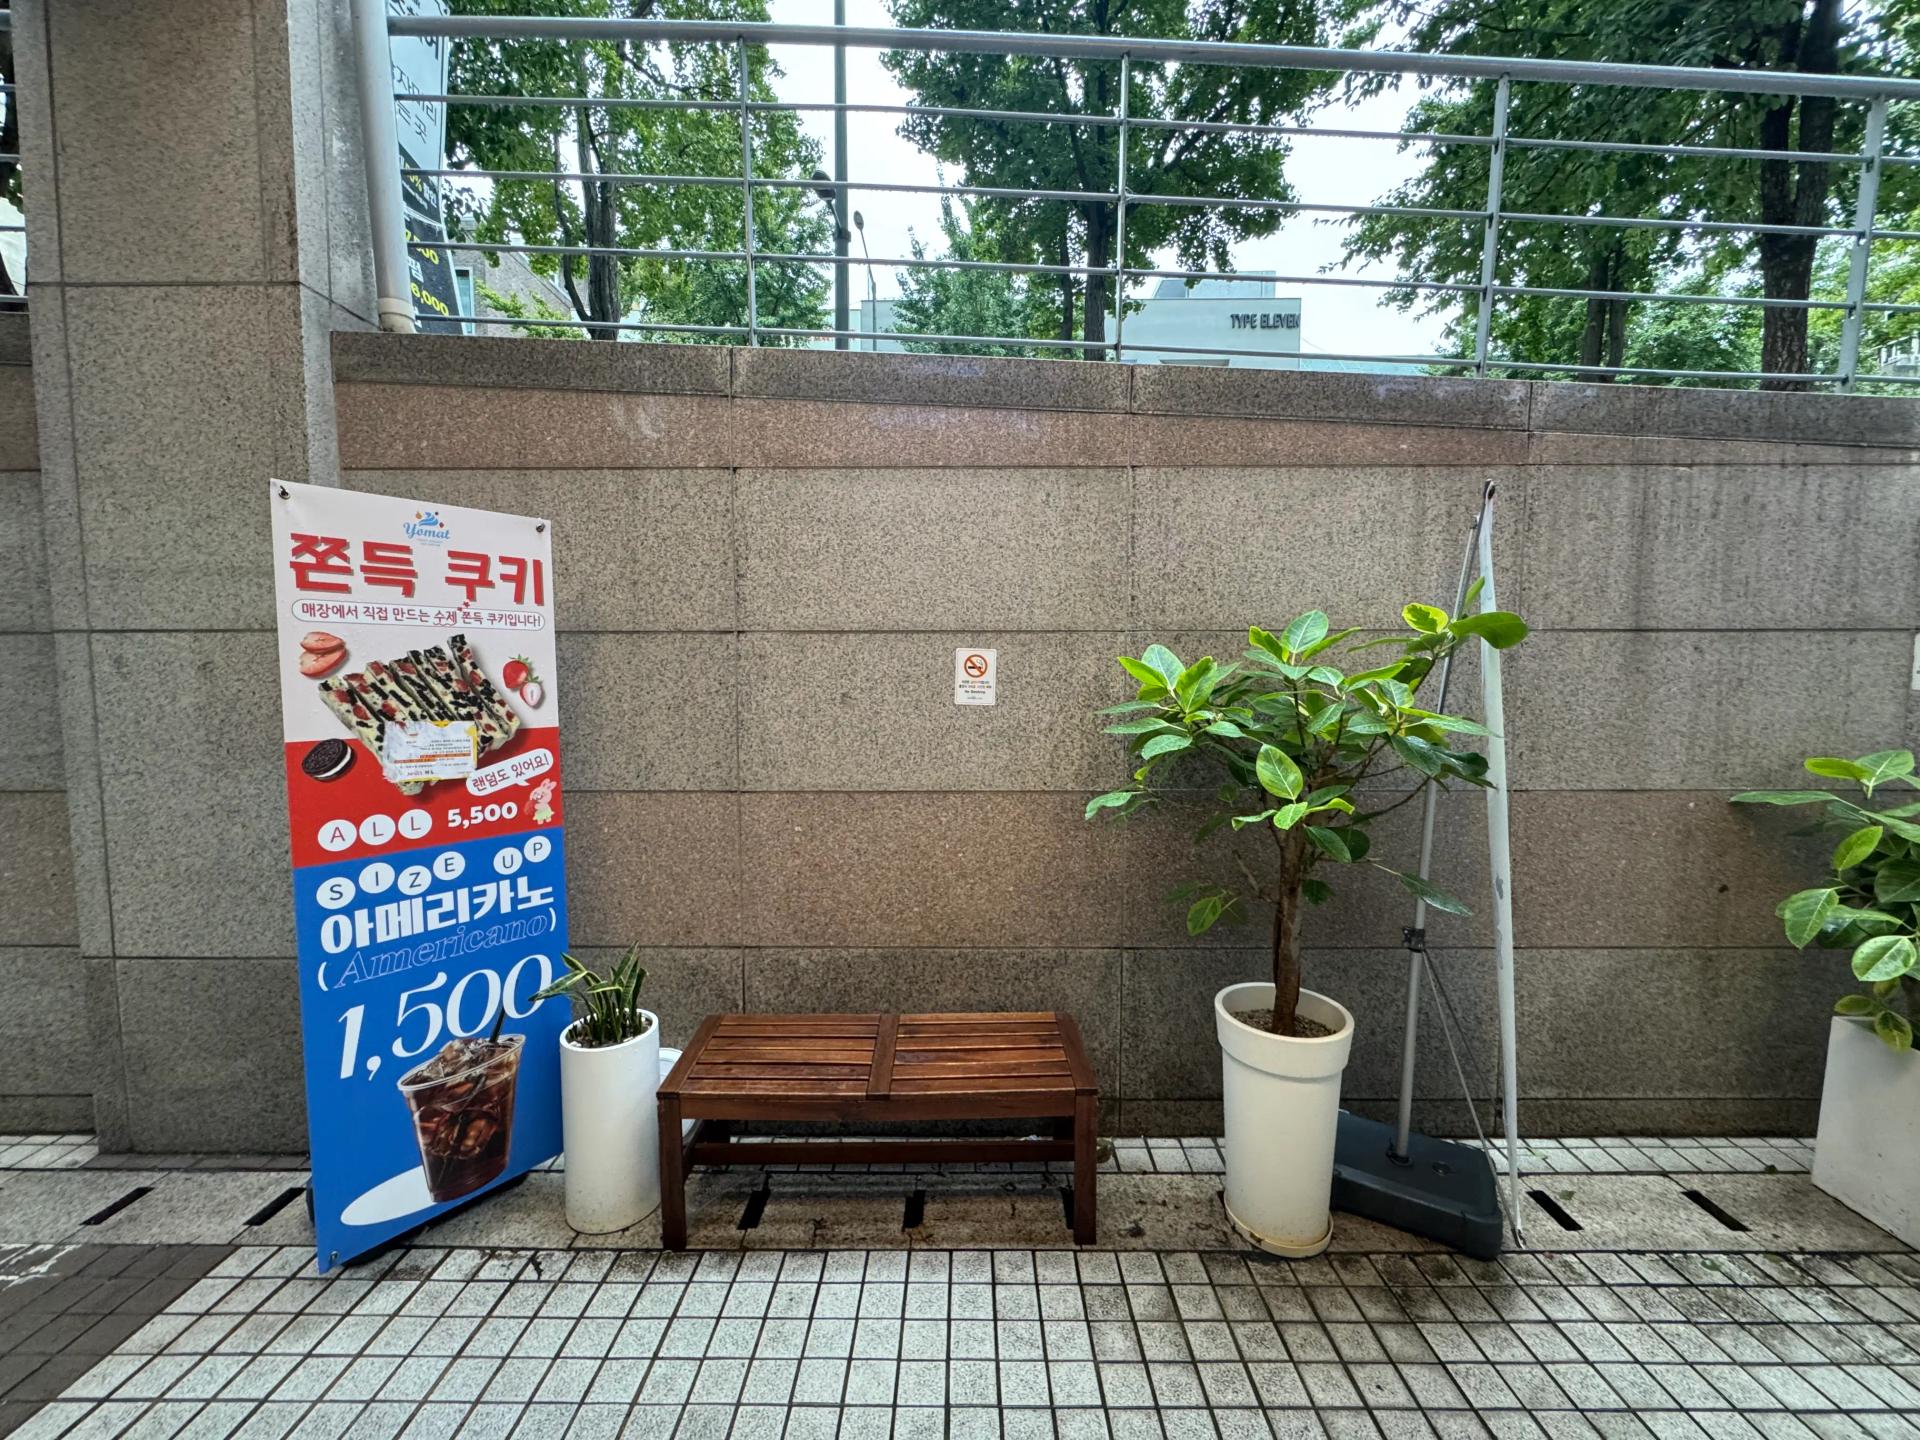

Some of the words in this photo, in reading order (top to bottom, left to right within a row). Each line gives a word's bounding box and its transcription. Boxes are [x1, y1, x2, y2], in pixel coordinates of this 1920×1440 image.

[1230, 313, 1257, 329] TYPE
[1260, 313, 1300, 329] ELEVEN
[403, 522, 450, 540] Yomat
[290, 533, 417, 598] 쫀득
[445, 550, 545, 606] 쿠키
[302, 603, 358, 619] 매장에서
[363, 606, 388, 621] 직접
[393, 608, 430, 623] 만드는
[433, 610, 458, 625] 수제
[461, 611, 484, 625] 쫀득
[487, 612, 541, 628] 쿠키입니다!
[472, 768, 510, 792] 랜덤도
[511, 753, 549, 778] 있어요!
[448, 801, 518, 829] 5,500
[326, 856, 458, 902] SIZE
[500, 841, 545, 870] UP
[320, 876, 554, 954] 아메리카노
[338, 954, 553, 1081] 1,500
